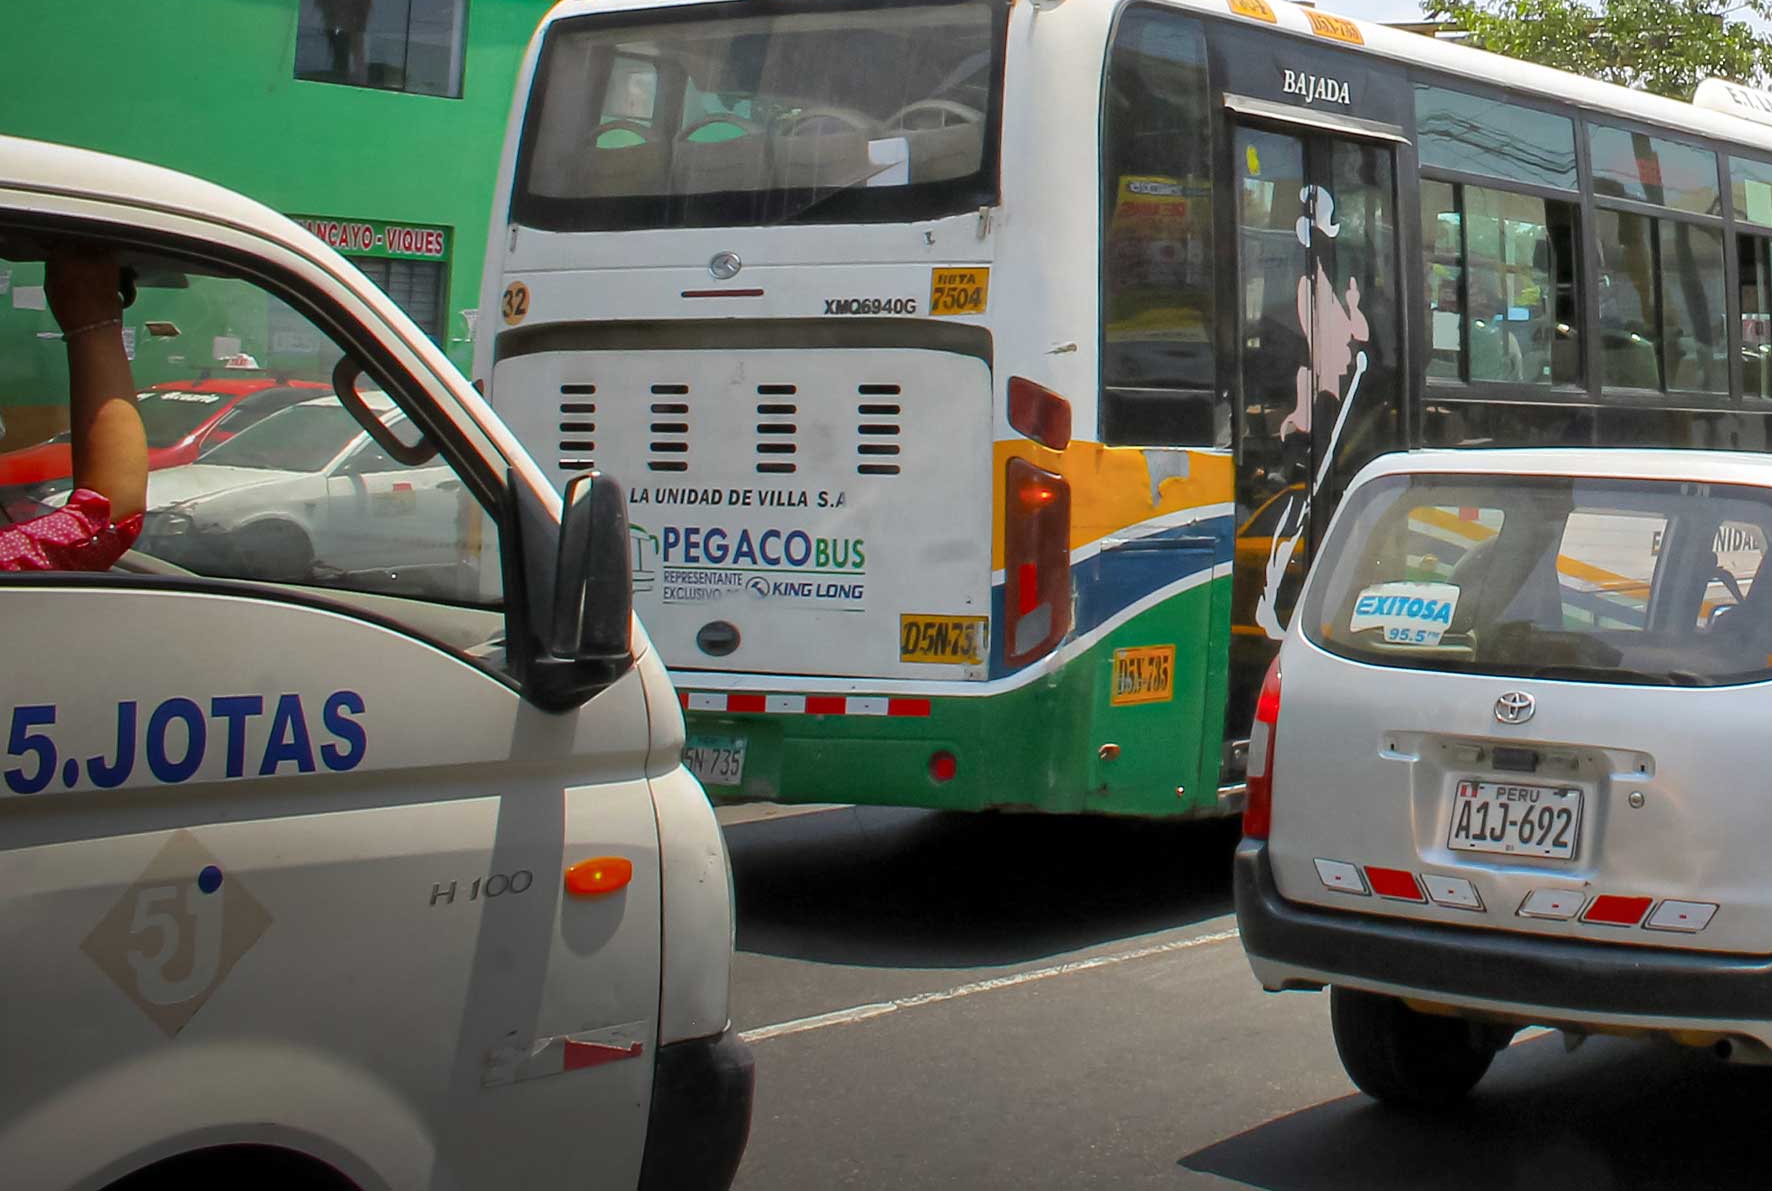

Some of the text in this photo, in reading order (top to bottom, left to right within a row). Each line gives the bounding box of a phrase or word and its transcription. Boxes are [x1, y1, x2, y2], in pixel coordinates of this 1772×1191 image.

[1283, 69, 1350, 105] BAJADA
[386, 226, 445, 256] VIQUES
[502, 288, 527, 318] 32
[824, 296, 918, 316] XMQ6940G
[932, 286, 983, 311] 7504
[629, 488, 650, 504] LA
[654, 488, 723, 506] UNIDAD
[728, 490, 753, 506] DE
[758, 490, 808, 507] VILLA
[663, 570, 865, 600] REPRESENTANTE KING LONG
[1356, 596, 1451, 624] EXITOSA
[1389, 628, 1426, 642] 95.5
[3, 690, 368, 794] 5.JOTAS
[1496, 787, 1540, 803] PERU
[1455, 799, 1573, 849] A1J-692
[470, 868, 534, 903] 100
